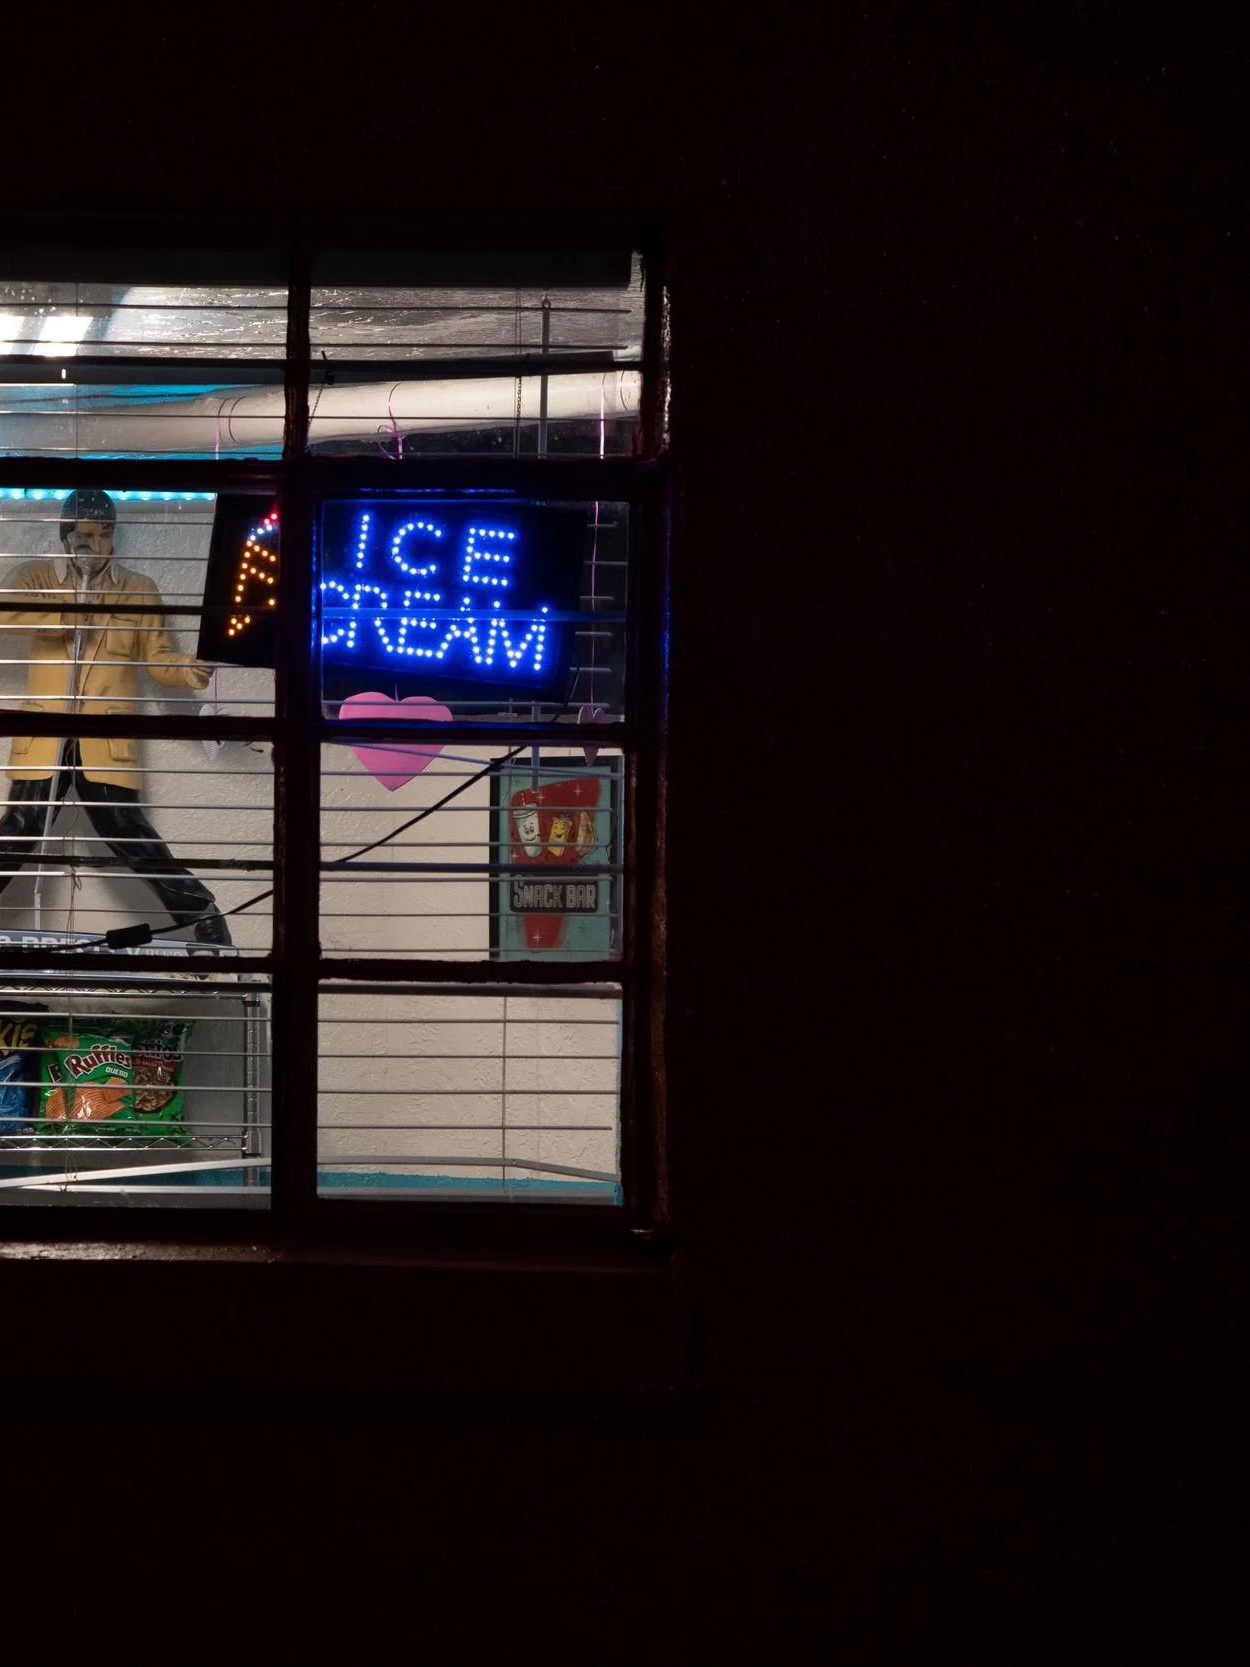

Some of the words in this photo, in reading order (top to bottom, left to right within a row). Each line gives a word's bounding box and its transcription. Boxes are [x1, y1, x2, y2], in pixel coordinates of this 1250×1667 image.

[355, 512, 518, 586] ICE
[513, 874, 563, 908] SNACK
[566, 884, 596, 909] BAR
[63, 1043, 132, 1080] Ruffles
[105, 1067, 129, 1078] QUESO
